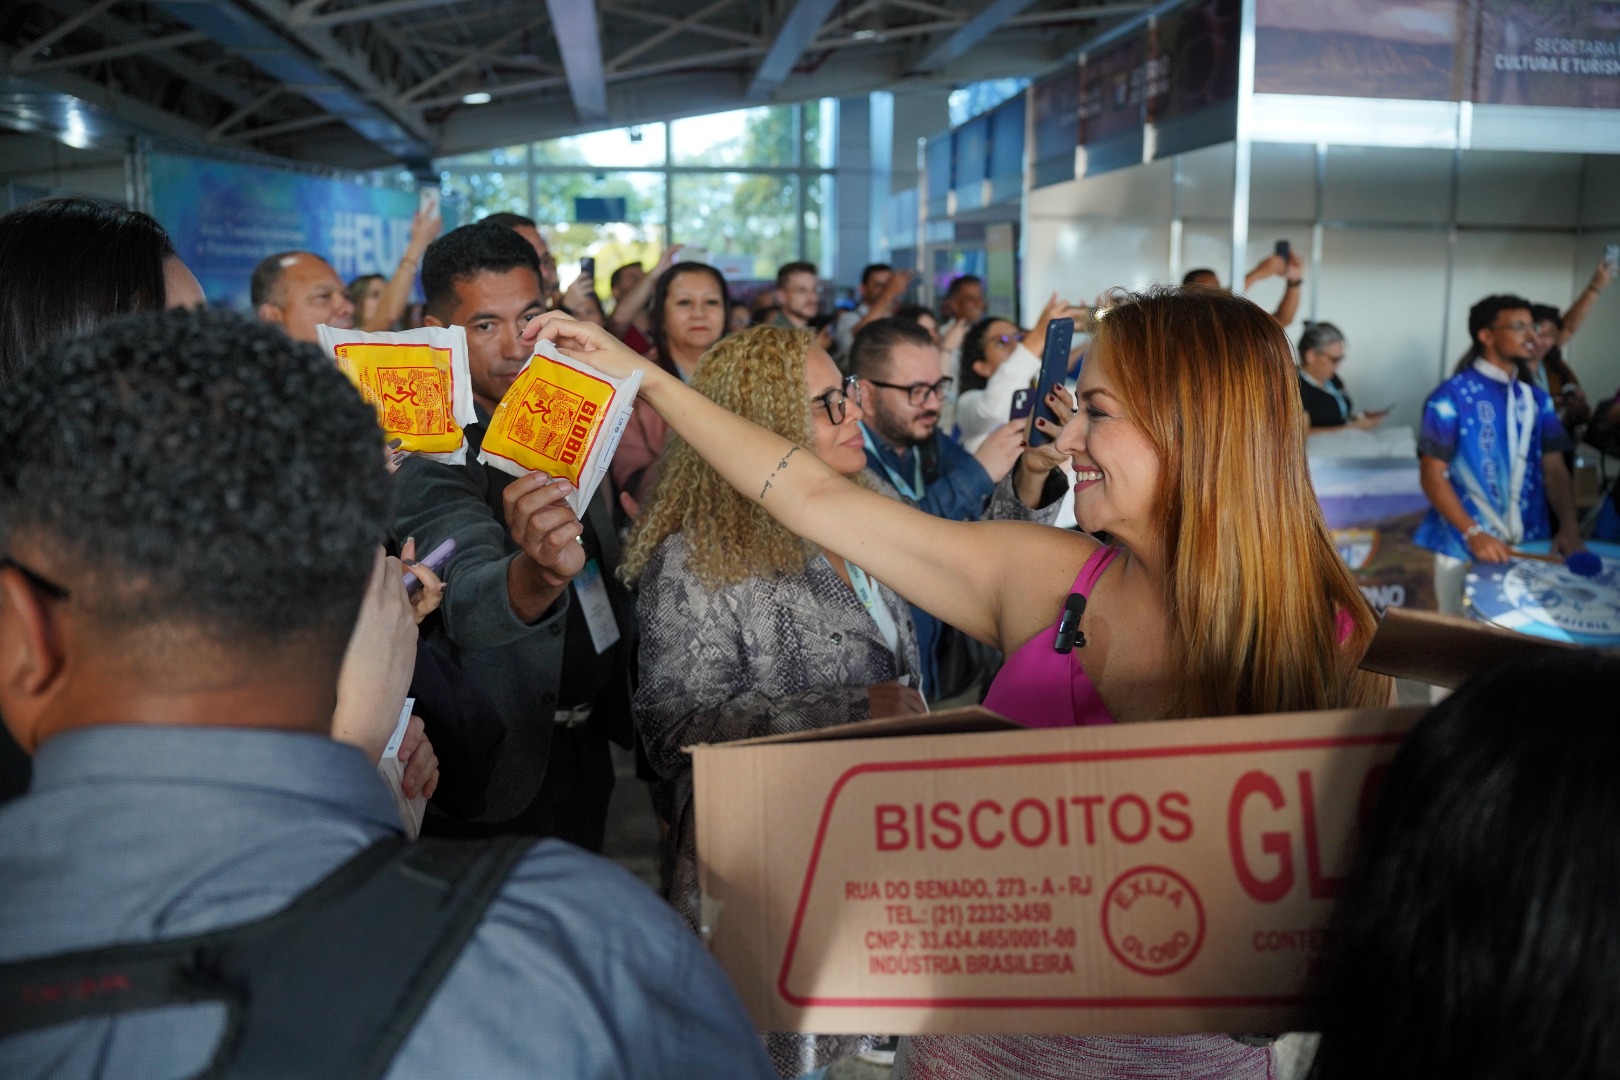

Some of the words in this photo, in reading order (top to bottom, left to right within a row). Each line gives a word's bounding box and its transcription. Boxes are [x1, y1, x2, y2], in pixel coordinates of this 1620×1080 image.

[1534, 37, 1616, 56] SECRETARIA
[1494, 53, 1559, 72] CULTURA
[1560, 56, 1571, 73] E
[560, 400, 598, 465] GLOBO
[875, 791, 1195, 852] BISCOITOS
[1227, 765, 1390, 904] GL
[845, 880, 880, 900] RUA
[885, 879, 910, 899] DO
[914, 878, 993, 902] SENADO,
[996, 877, 1026, 898] 273
[1040, 877, 1055, 897] A
[1068, 876, 1093, 896] RJ
[1113, 877, 1184, 911] EXIJA
[885, 904, 927, 924] TEL.:
[932, 903, 963, 928] (21)
[864, 929, 914, 952] CNPJ:
[1122, 930, 1191, 964] GLOBO
[869, 950, 962, 975] INDÚSTRIA
[966, 953, 1074, 975] BRASILEIRA
